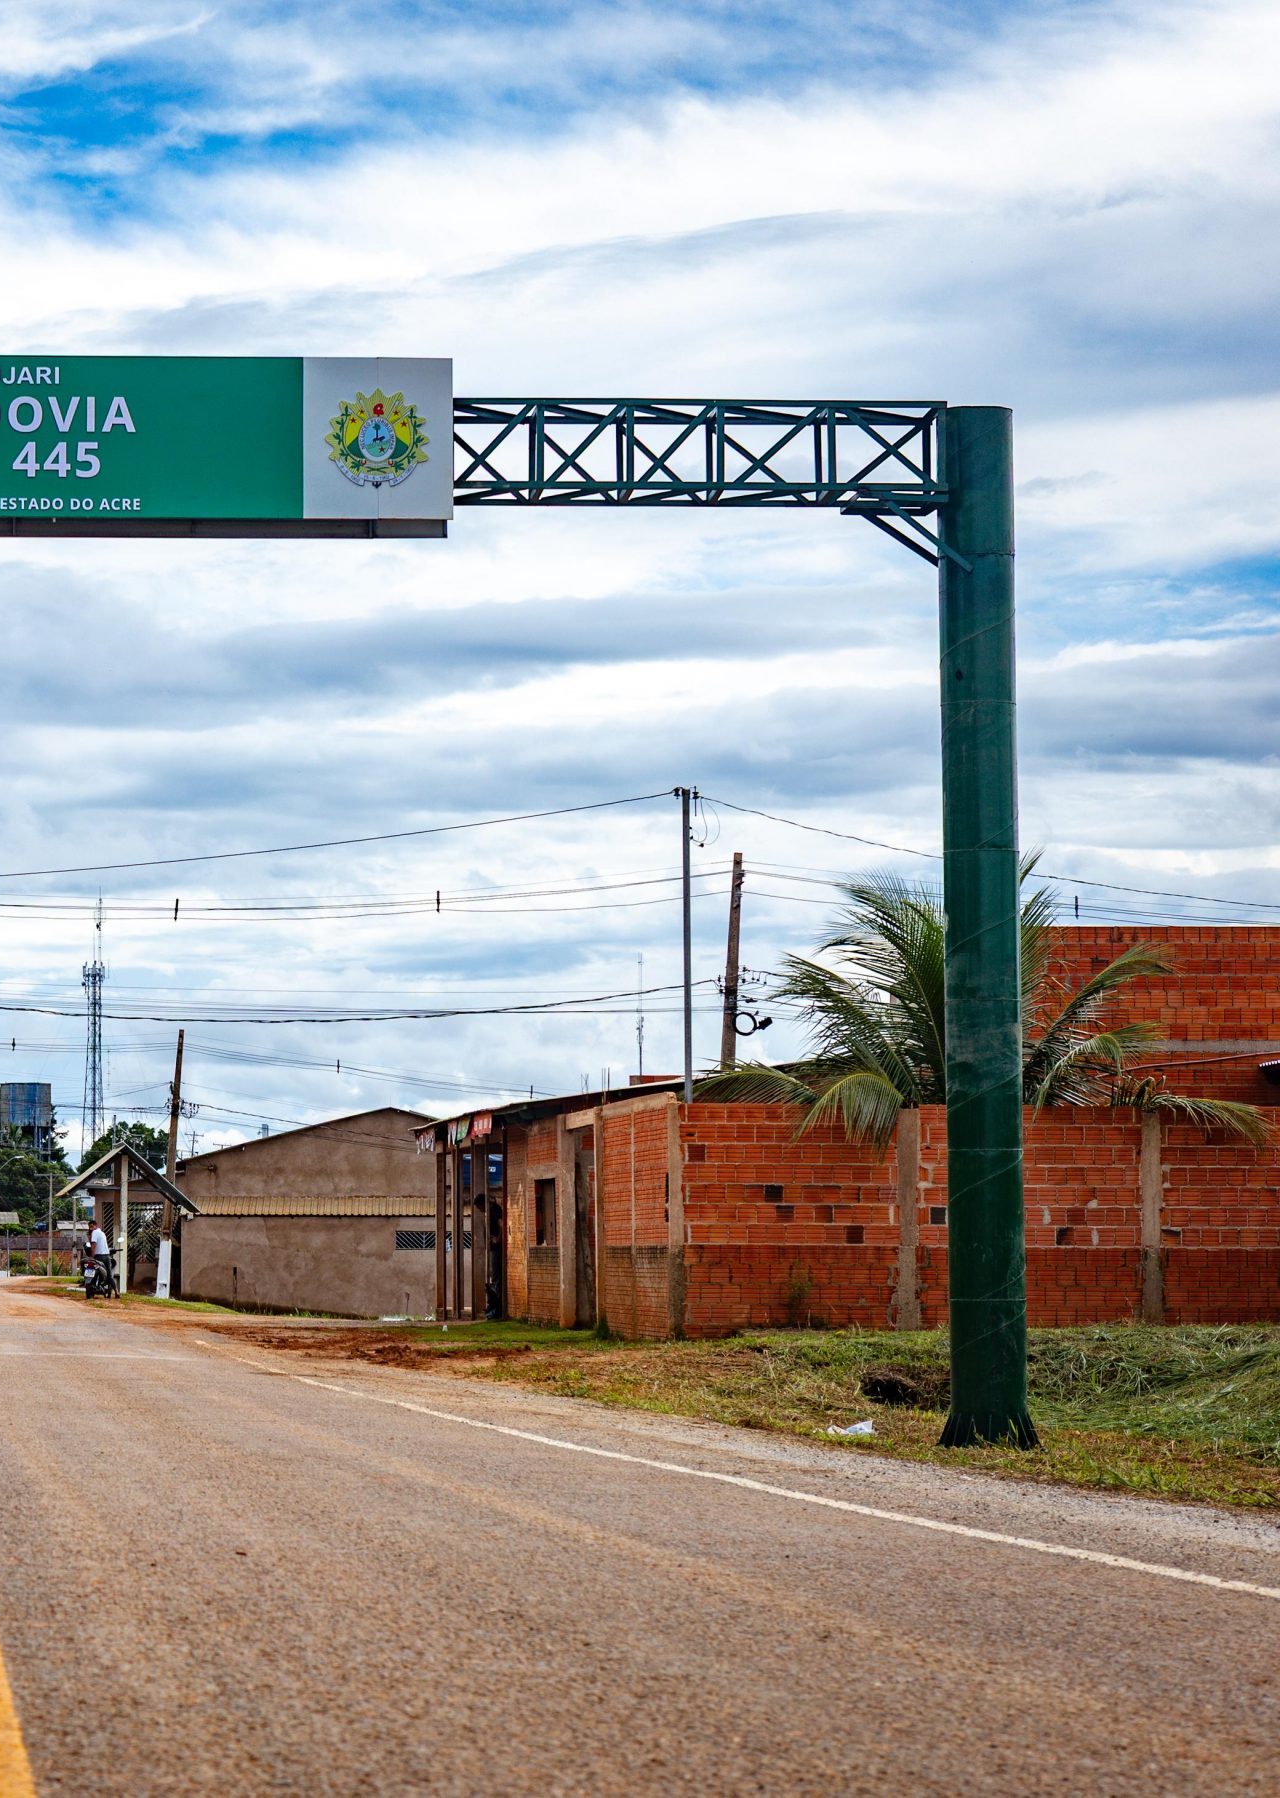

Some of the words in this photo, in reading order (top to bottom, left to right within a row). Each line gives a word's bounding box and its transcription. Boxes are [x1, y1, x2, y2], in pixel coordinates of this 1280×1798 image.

[12, 441, 101, 478] 445
[0, 497, 64, 511] ESTADO
[70, 498, 94, 511] DO
[99, 498, 141, 511] ACRE
